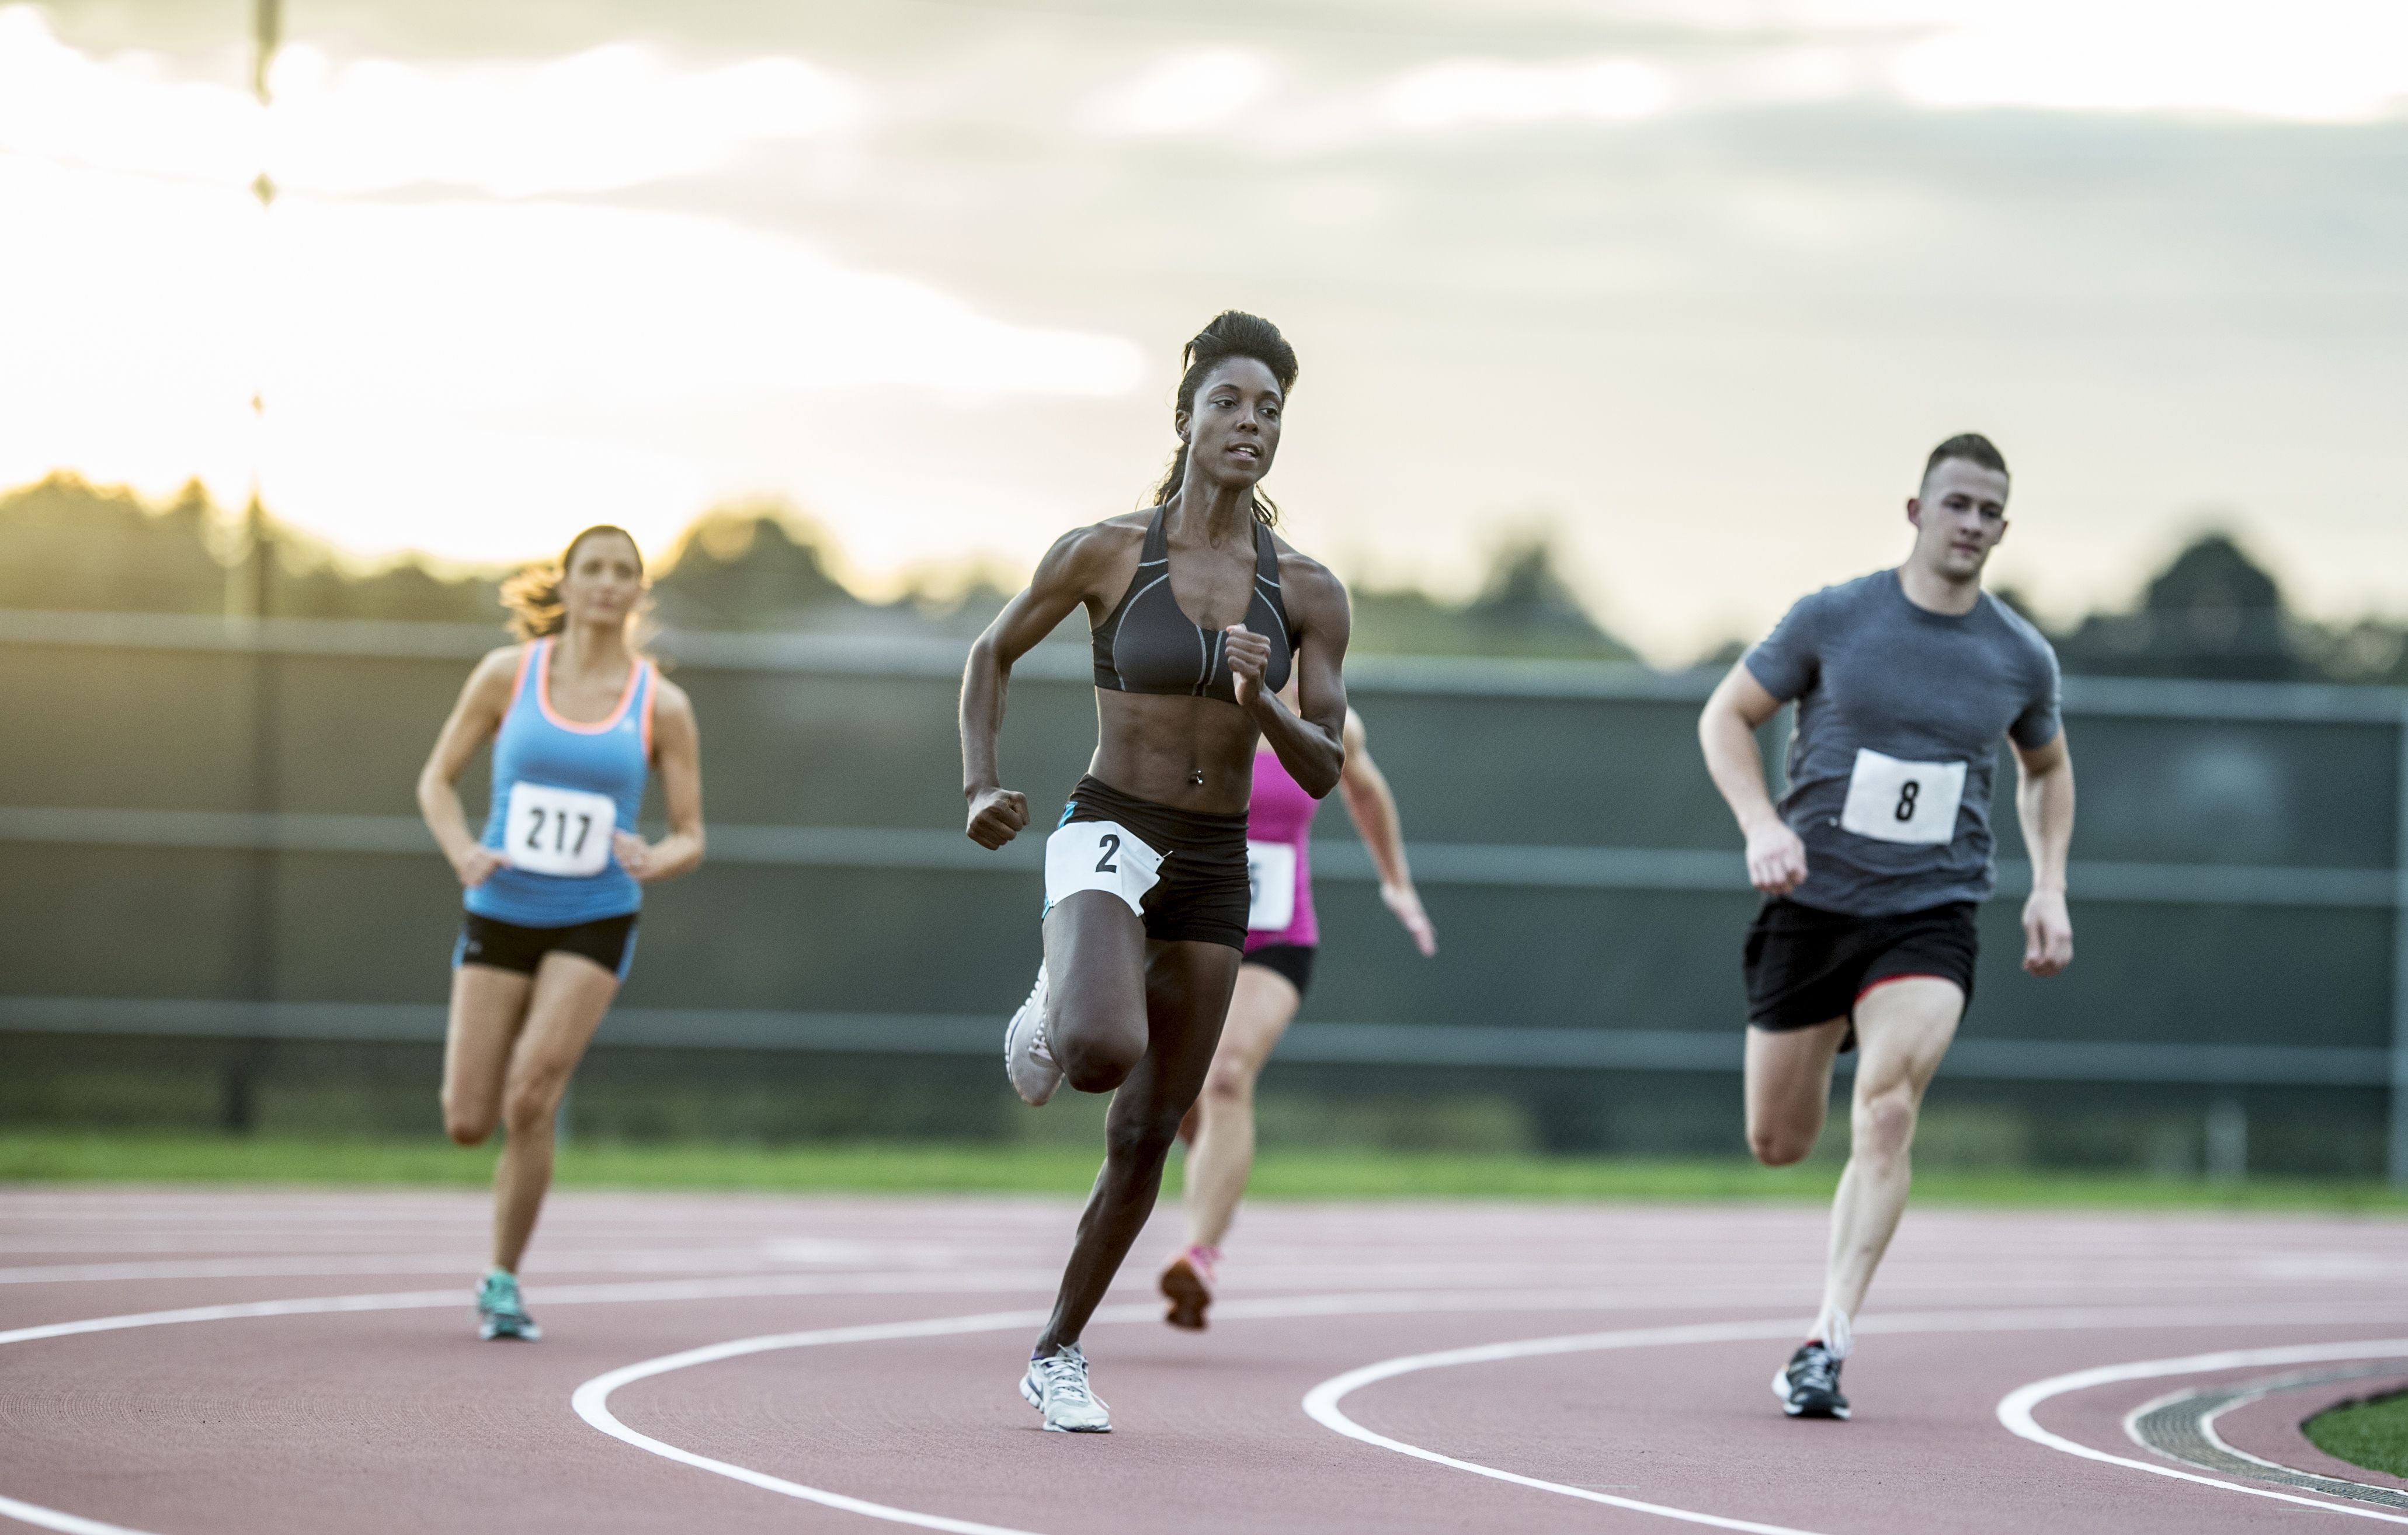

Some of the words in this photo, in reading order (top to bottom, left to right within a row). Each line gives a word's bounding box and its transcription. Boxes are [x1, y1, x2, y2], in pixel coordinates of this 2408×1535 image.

[1896, 781, 1919, 822] 8
[527, 807, 591, 855] 217
[1095, 834, 1121, 874] 2
